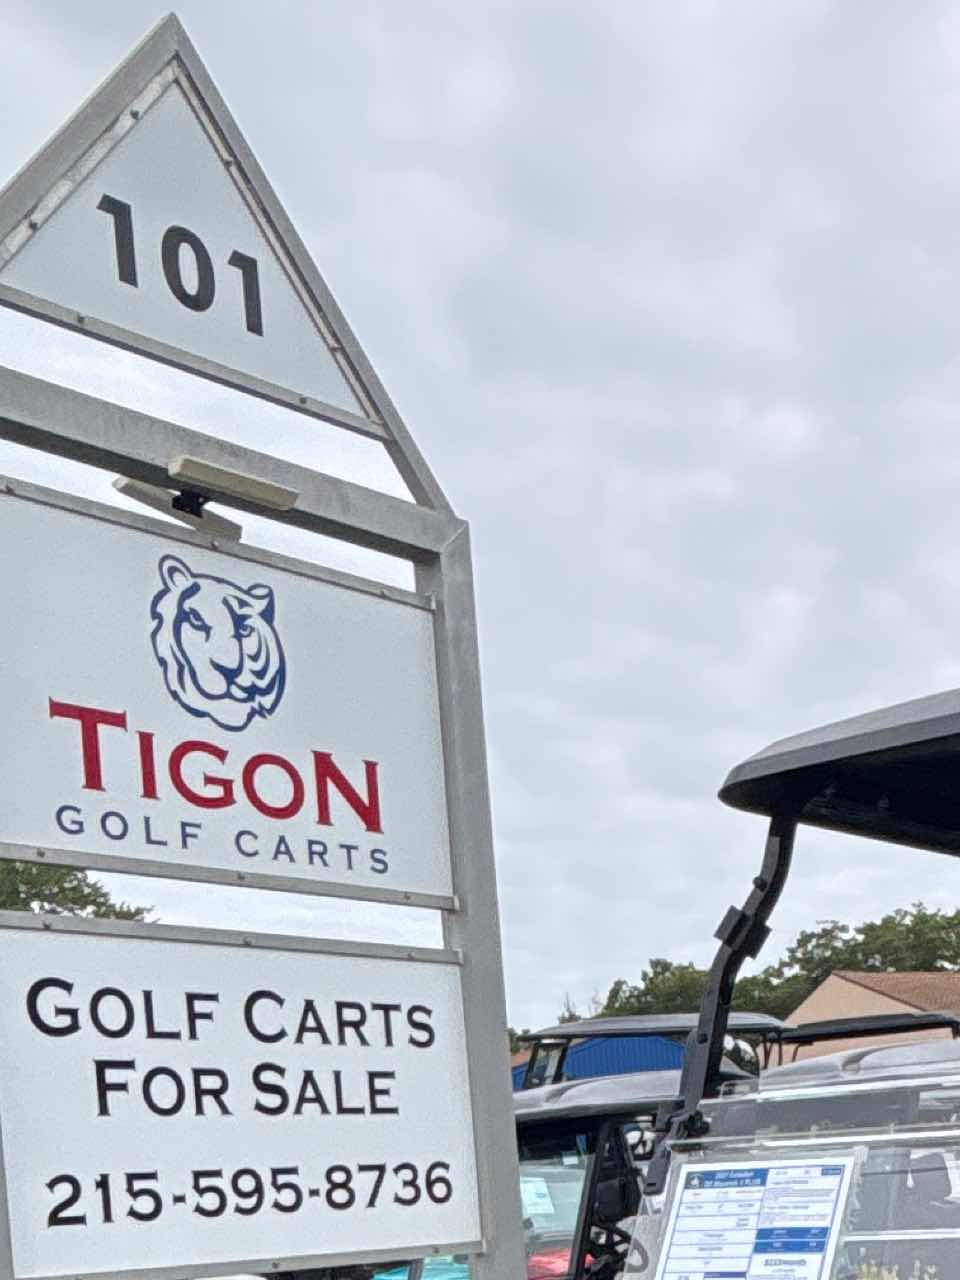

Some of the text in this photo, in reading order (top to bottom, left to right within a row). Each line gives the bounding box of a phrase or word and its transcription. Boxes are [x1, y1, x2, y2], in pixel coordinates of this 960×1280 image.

[96, 193, 264, 337] 101
[48, 696, 384, 834] TIGON
[55, 804, 389, 875] GOLF CARTS
[26, 977, 436, 1049] GOLF CARTS
[93, 1059, 400, 1117] FOR SALE
[45, 1161, 454, 1228] 215-595-8736
